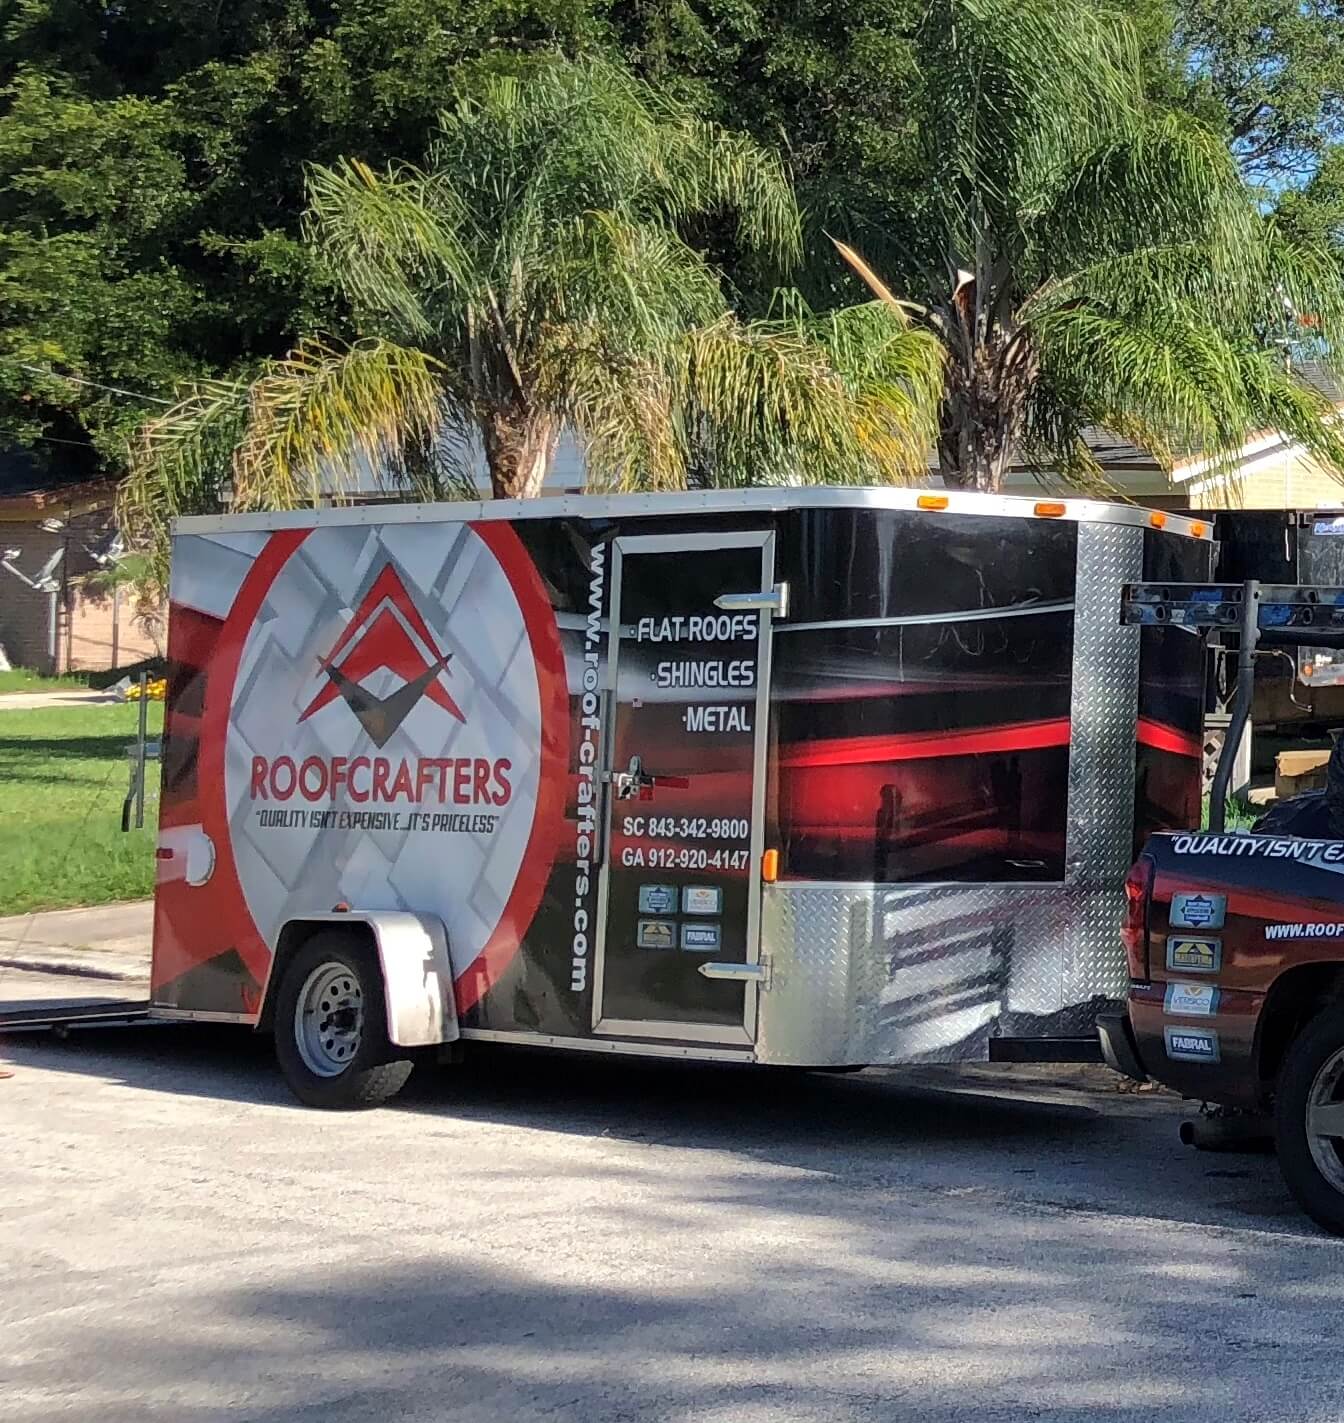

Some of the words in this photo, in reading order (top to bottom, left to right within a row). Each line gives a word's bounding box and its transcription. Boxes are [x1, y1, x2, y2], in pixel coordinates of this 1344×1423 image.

[688, 614, 757, 641] ROOFS
[571, 542, 605, 992] www.roof-crafters.com
[249, 755, 513, 807] ROOFCRAFTERS
[622, 816, 645, 837] SC
[647, 817, 749, 839] 843-342-9800
[621, 847, 645, 867] GA
[648, 848, 750, 870] 912-920-4147
[1171, 835, 1266, 857] "QUALITY
[1262, 839, 1326, 860] ISN'T
